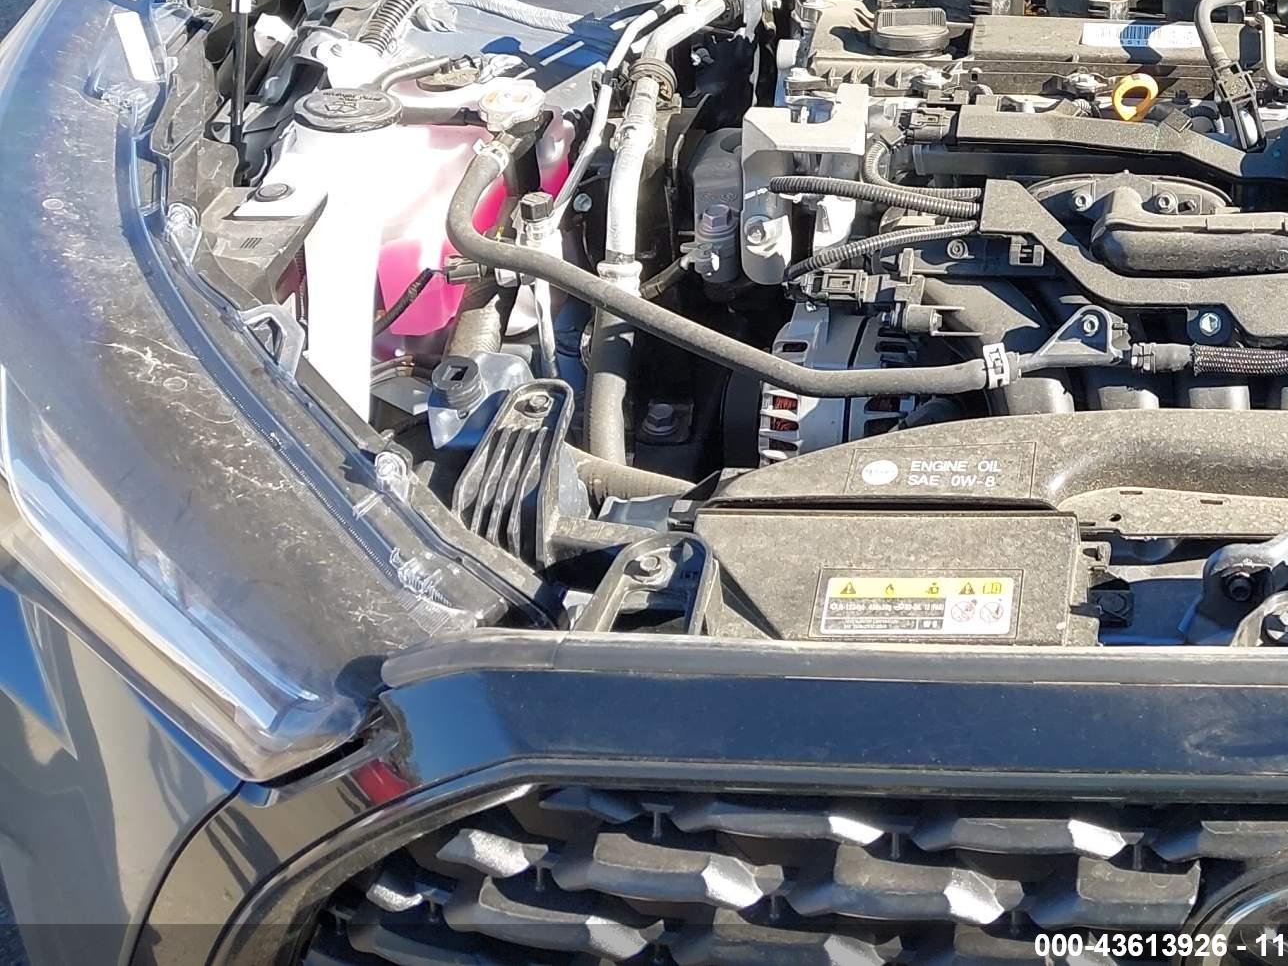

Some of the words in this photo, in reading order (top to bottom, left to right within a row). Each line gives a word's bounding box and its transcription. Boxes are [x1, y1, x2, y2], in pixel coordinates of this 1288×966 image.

[910, 460, 969, 472] ENGINE
[977, 459, 1002, 472] OIL
[907, 475, 941, 486] SAE
